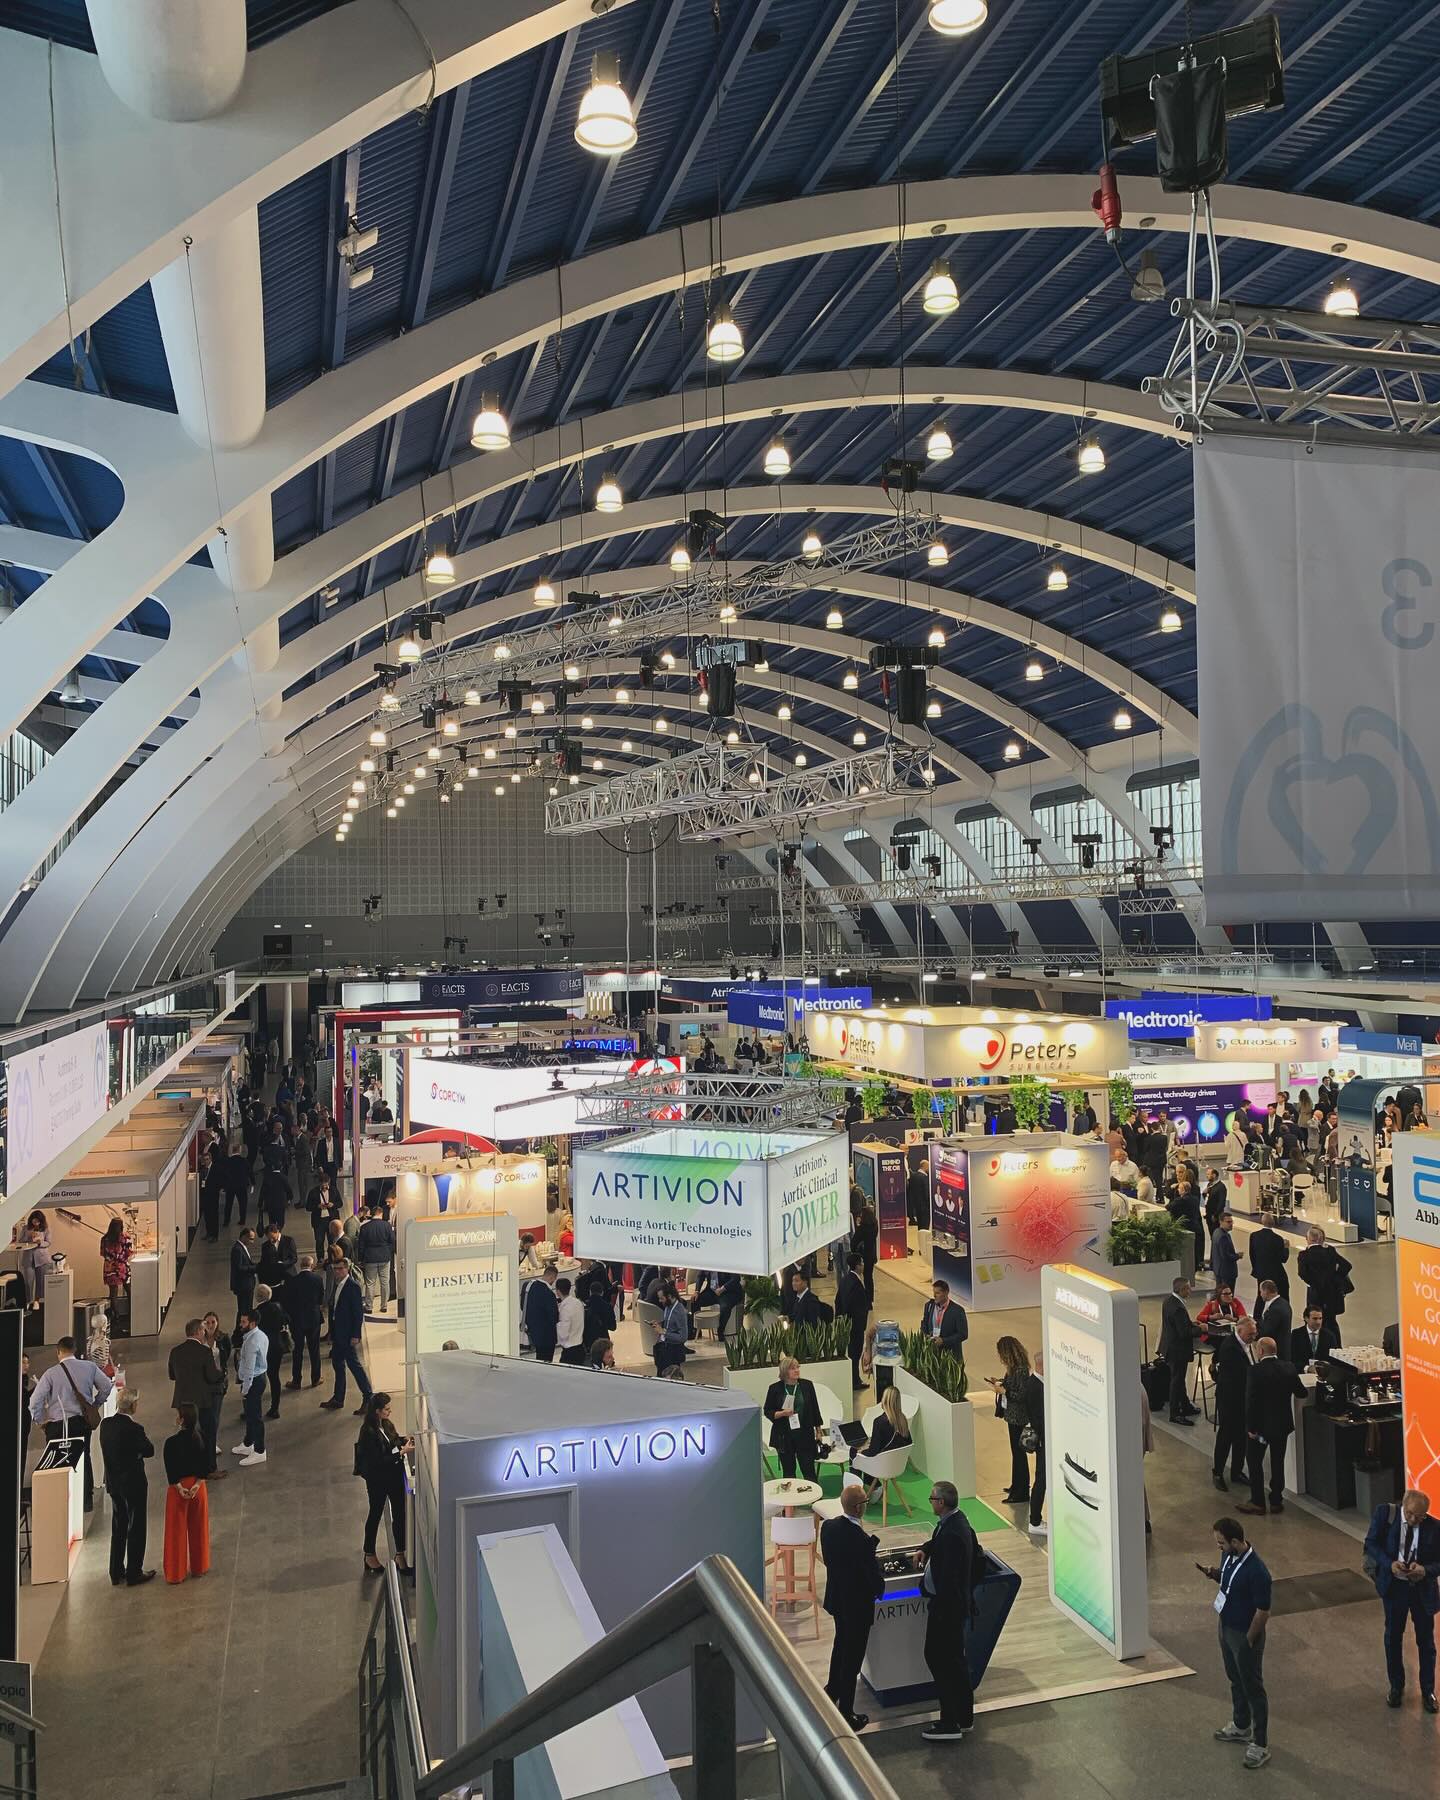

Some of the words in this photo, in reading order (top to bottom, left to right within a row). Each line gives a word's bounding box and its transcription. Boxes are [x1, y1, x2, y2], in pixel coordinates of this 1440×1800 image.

[442, 984, 465, 994] EACTS
[501, 982, 530, 992] EACTS
[758, 1004, 785, 1021] Medtronic
[793, 997, 862, 1012] Medtronic
[1118, 1010, 1202, 1029] Medtronic
[850, 1034, 875, 1056] Peters
[1010, 1041, 1077, 1060] Peters
[438, 1088, 466, 1104] CORCYM
[1134, 1092, 1163, 1101] powered,
[1164, 1090, 1197, 1099] technology
[1198, 1089, 1217, 1097] driven
[391, 1155, 418, 1163] CORCYM
[793, 1153, 828, 1178] Artivion's
[61, 1190, 82, 1198] Group
[592, 1171, 742, 1207] ARTIVION
[781, 1182, 807, 1208] Aortic
[808, 1167, 838, 1196] Clinical
[781, 1190, 840, 1246] POWER
[1415, 1208, 1440, 1226] Abb
[587, 1215, 642, 1230] Advancing
[644, 1220, 677, 1232] Aortic
[680, 1222, 752, 1239] Technologies
[429, 1230, 497, 1247] ARTIVION
[631, 1233, 654, 1245] with
[423, 1271, 503, 1289] PERSEVERE
[504, 1425, 706, 1481] ARTIVION
